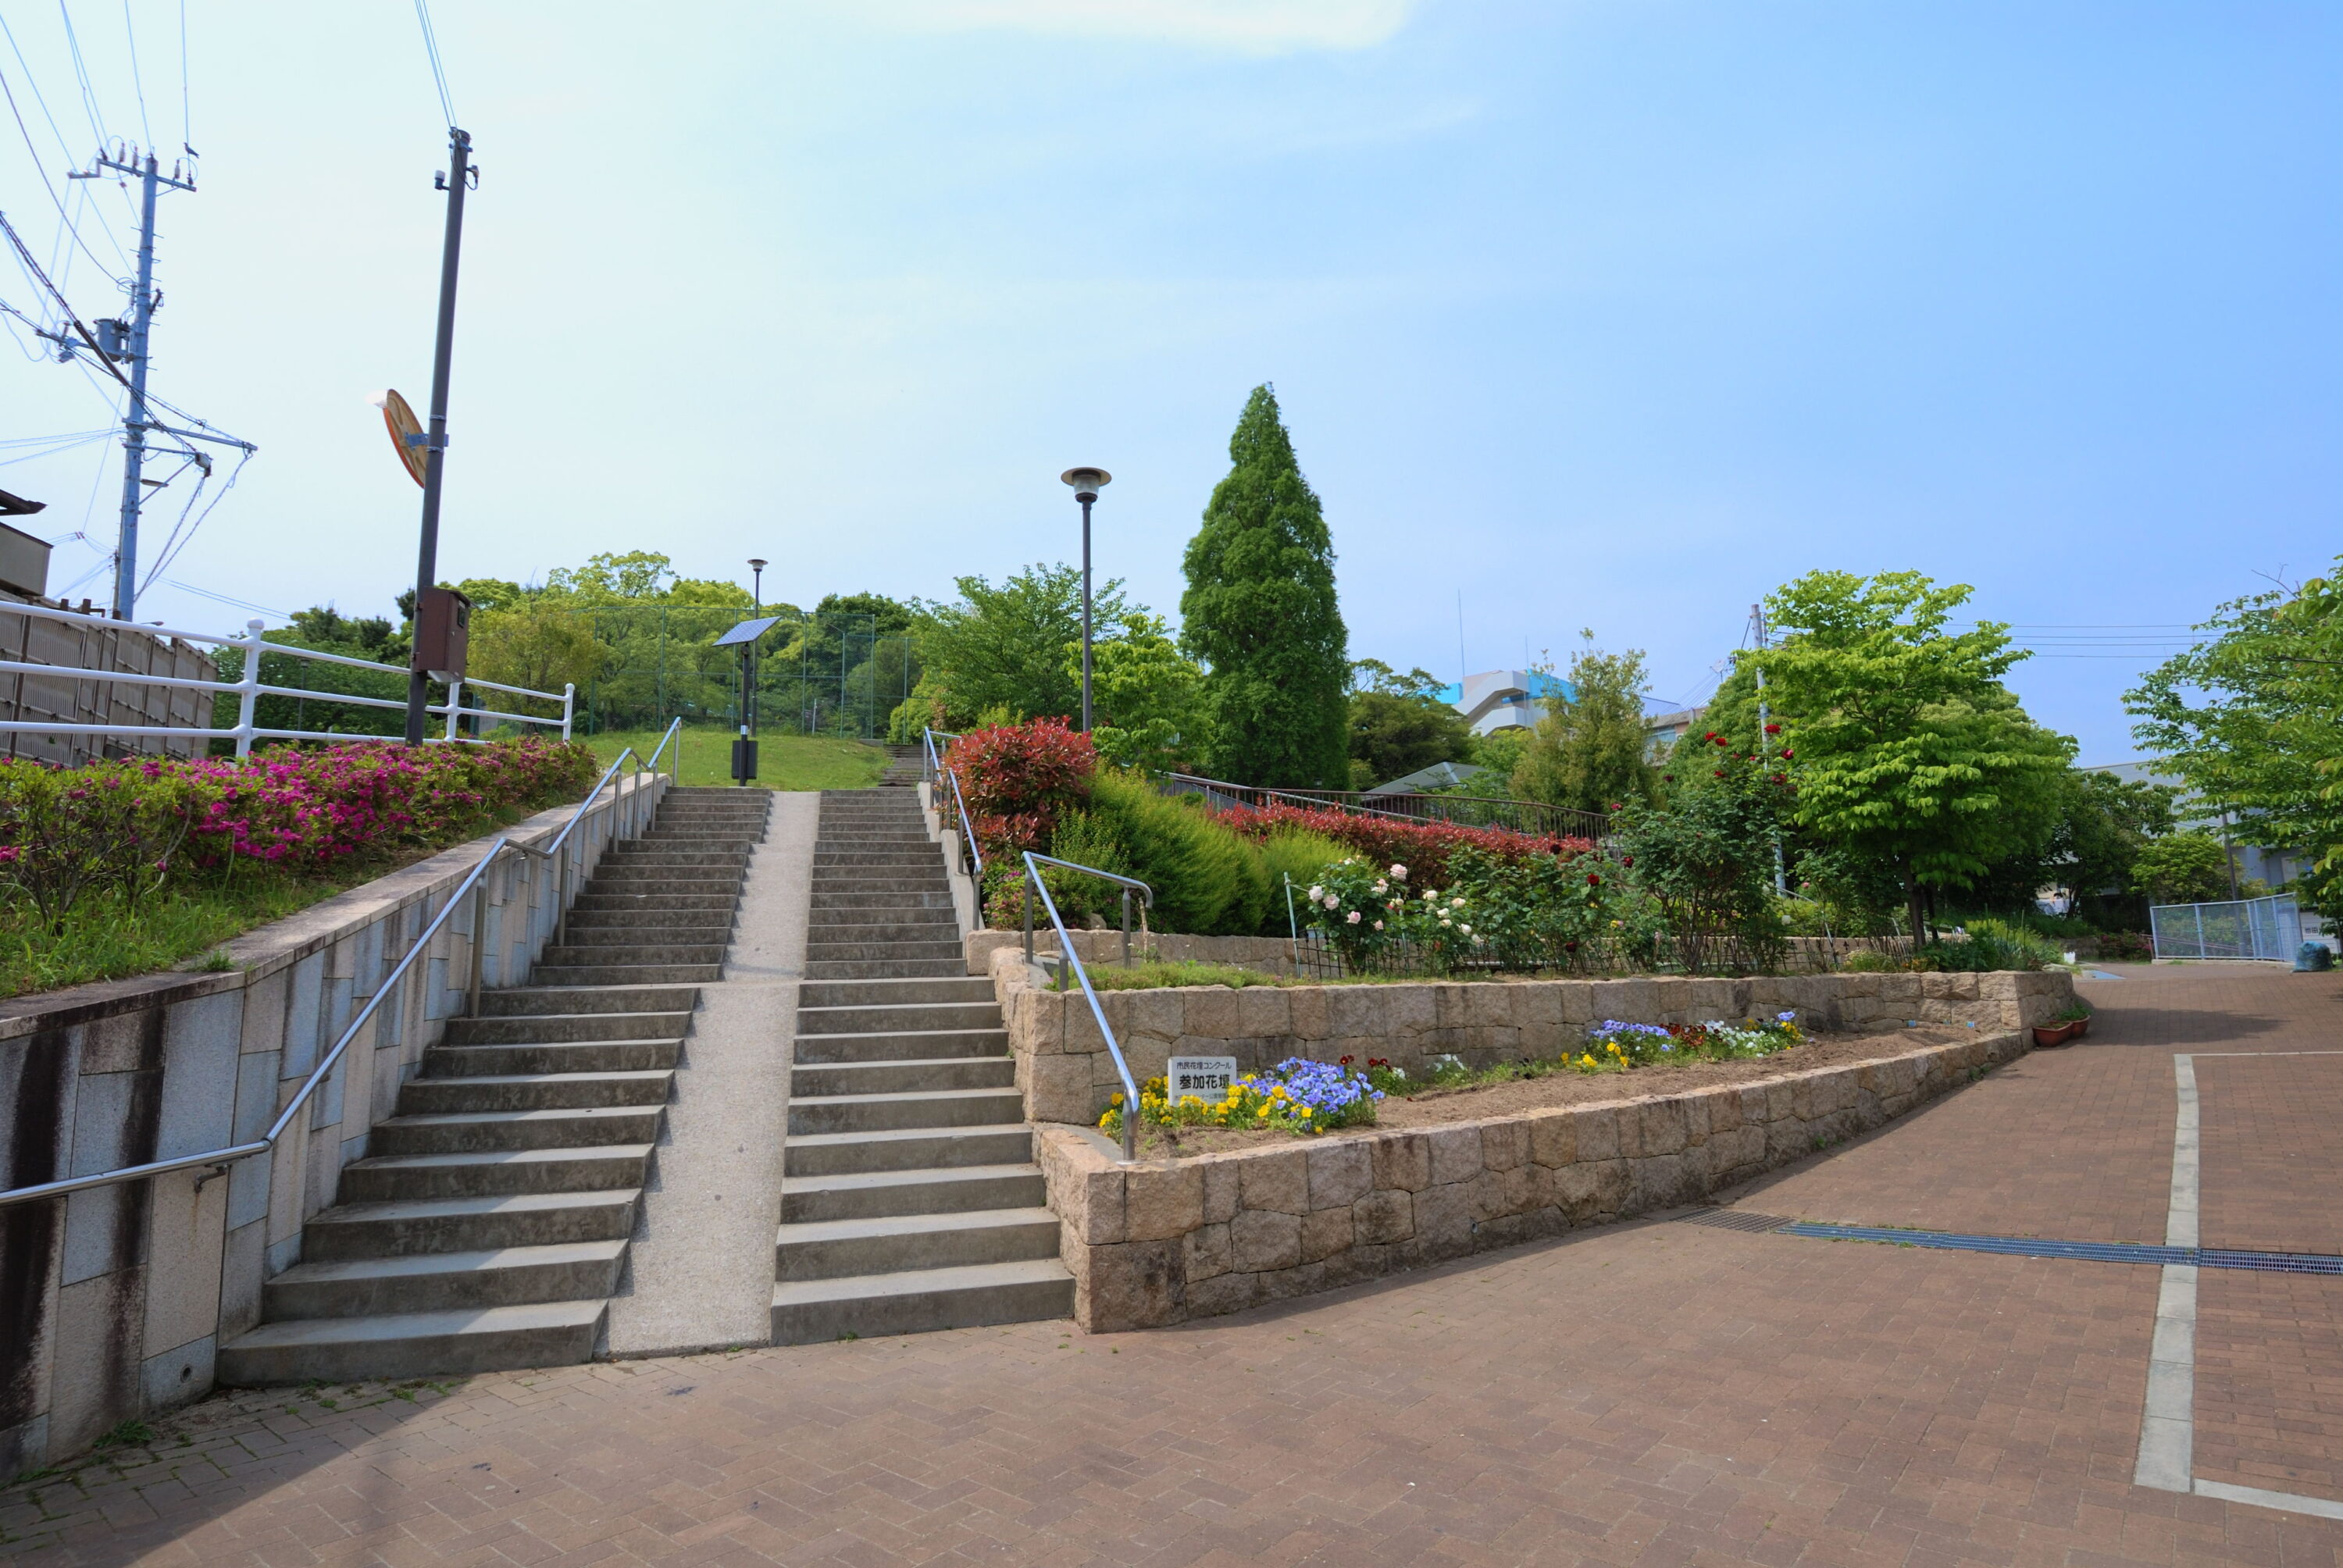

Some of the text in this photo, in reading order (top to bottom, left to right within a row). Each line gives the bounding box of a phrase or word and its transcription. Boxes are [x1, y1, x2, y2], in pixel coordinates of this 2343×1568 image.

[1176, 1061, 1232, 1071] 市民花壇コンクール
[1179, 1074, 1230, 1089] 参加花壇
